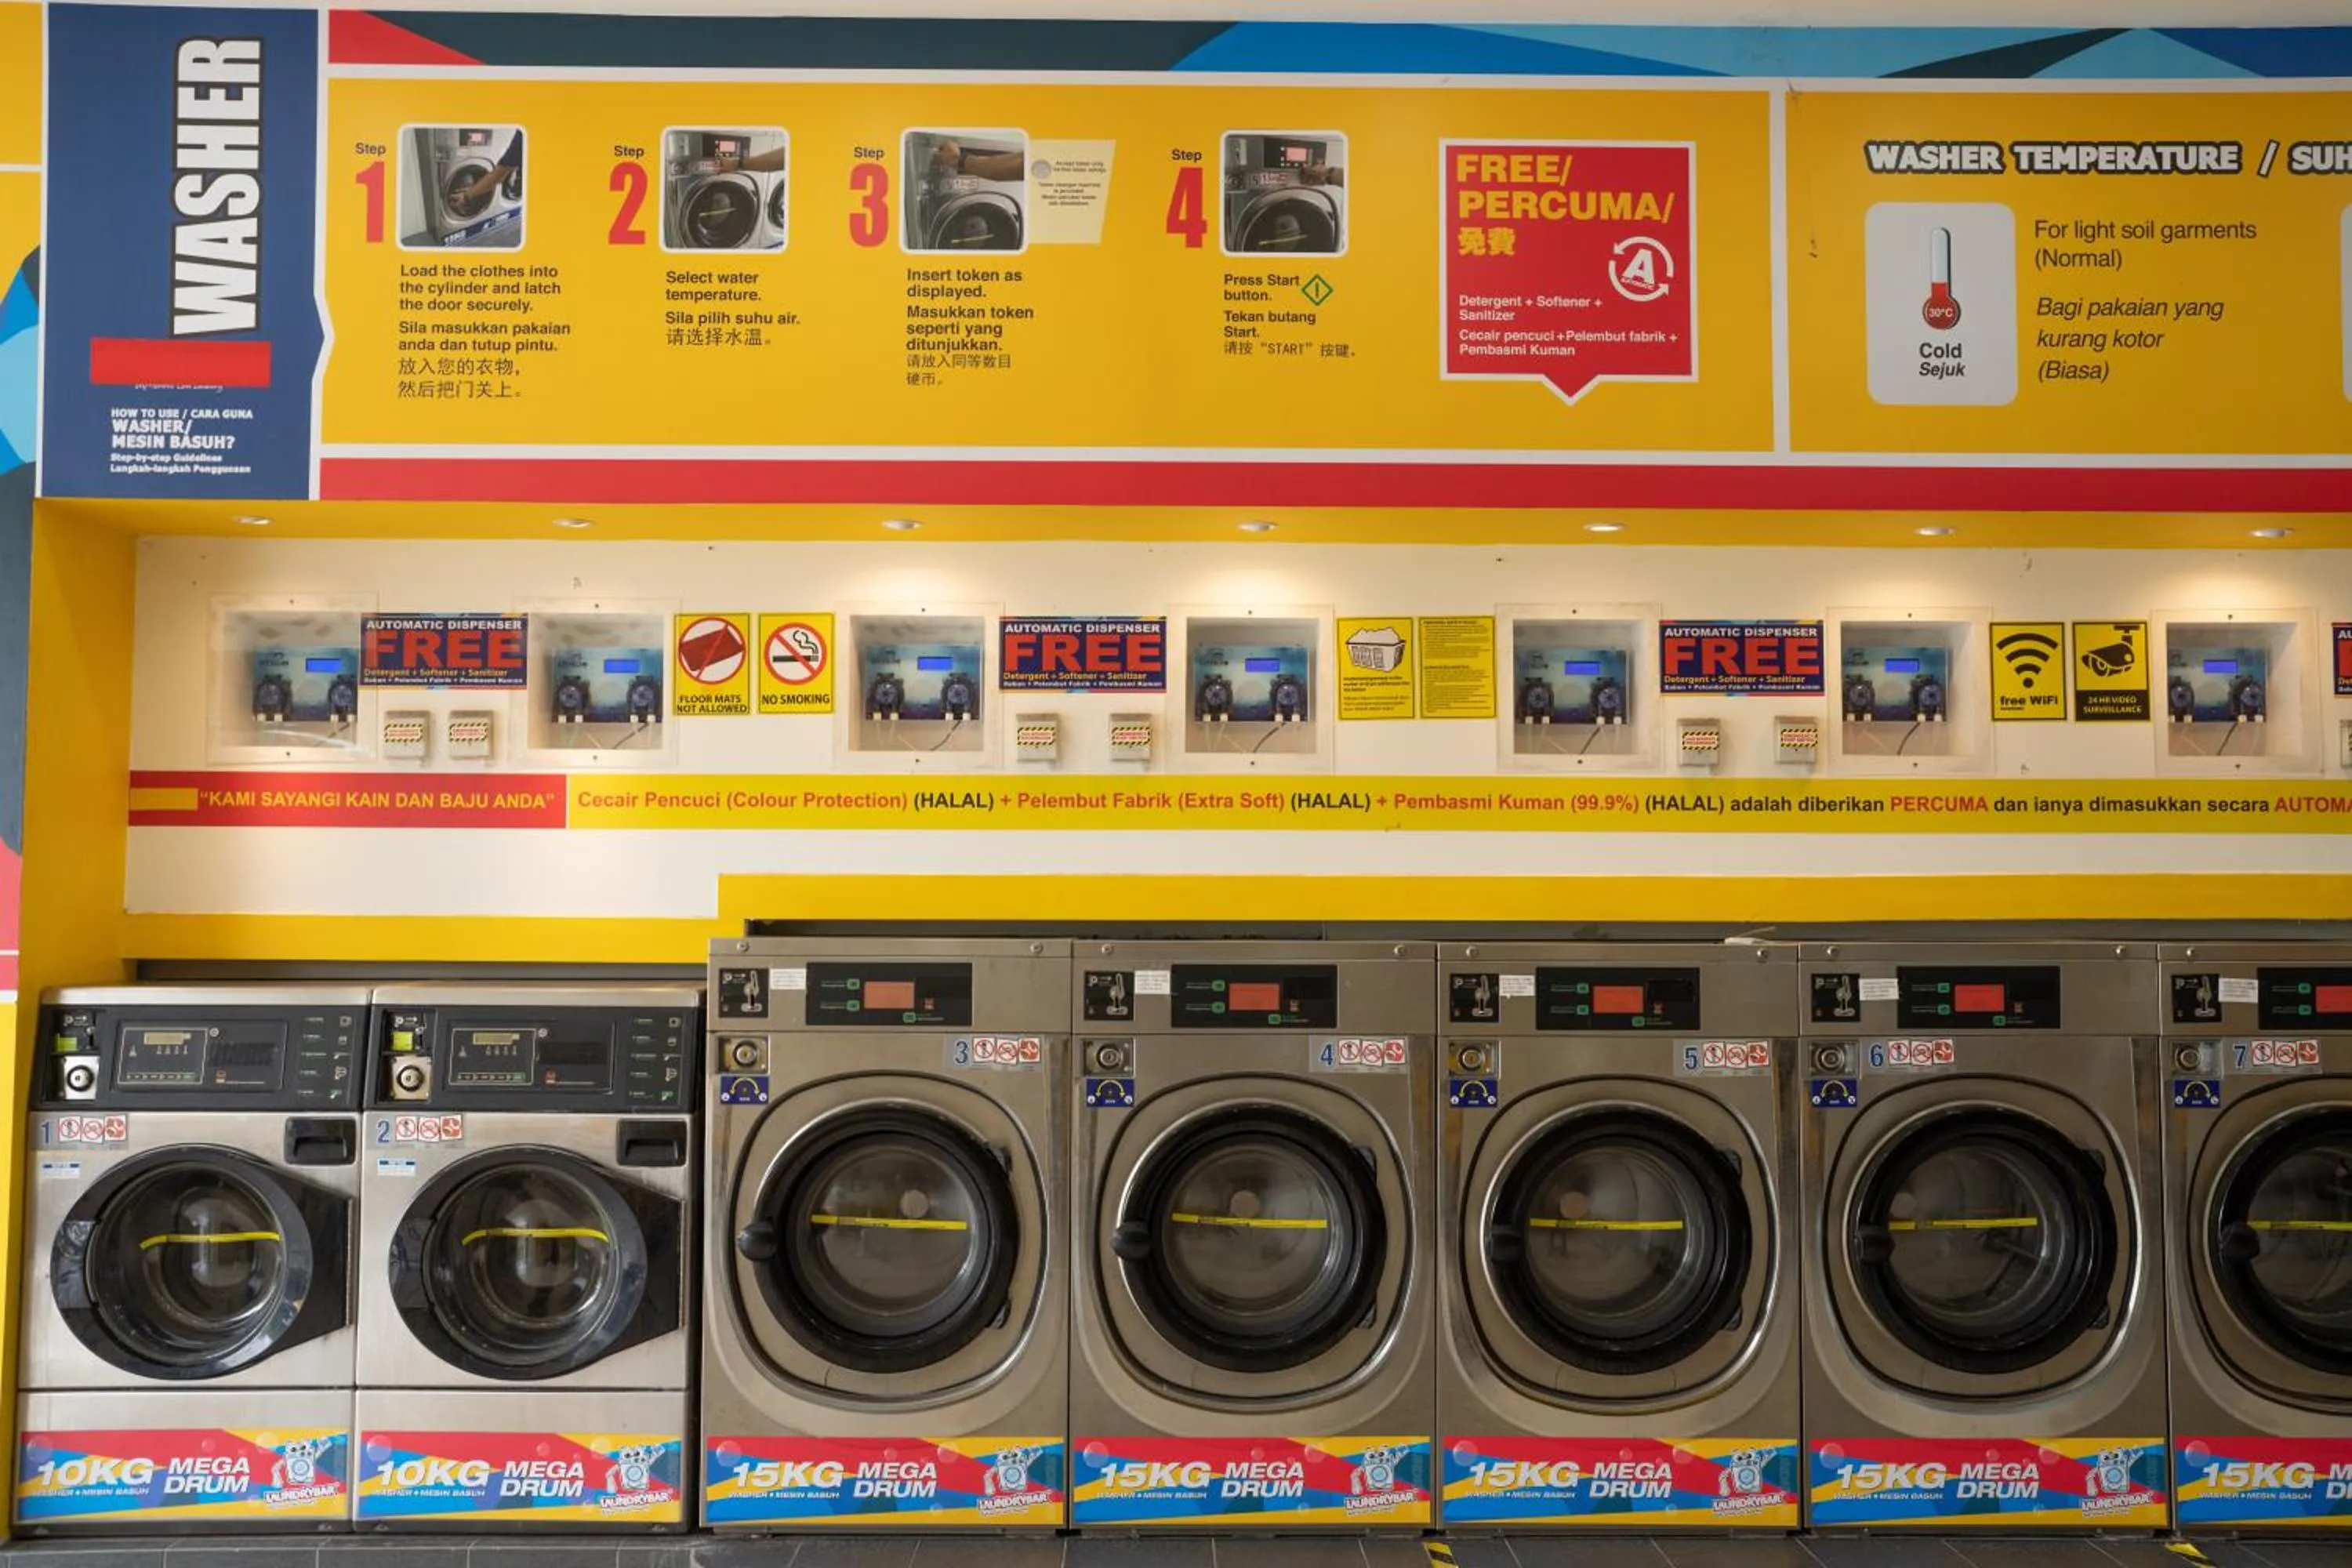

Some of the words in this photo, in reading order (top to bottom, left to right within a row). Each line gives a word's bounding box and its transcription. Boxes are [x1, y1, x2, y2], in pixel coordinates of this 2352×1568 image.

[356, 143, 386, 158] Step
[615, 147, 644, 160] Step
[855, 147, 884, 161] Step
[1172, 150, 1202, 163] Step
[1866, 141, 2004, 172] WASHER
[2012, 141, 2241, 172] TEMPERATURE
[2288, 142, 2352, 173] SUH
[1457, 155, 1571, 187] FREE/
[172, 37, 263, 337] WASHER
[356, 162, 385, 243] 1
[608, 162, 648, 245] 2
[850, 164, 888, 248] 3
[1167, 167, 1207, 249] 4
[1459, 191, 1674, 223] PERCUMA/
[2035, 221, 2067, 239] For
[2075, 221, 2114, 244] light
[2122, 221, 2154, 239] soil
[2161, 222, 2257, 245] garments
[2035, 249, 2122, 271] (Normal)
[401, 265, 437, 277] Load
[442, 266, 466, 277] the
[470, 266, 524, 277] clothes
[530, 267, 557, 277] into
[666, 272, 712, 285] Select
[717, 274, 758, 285] water
[908, 270, 951, 281] Insert
[956, 270, 999, 281] token
[1004, 272, 1022, 281] as
[1225, 275, 1262, 286] Press
[1268, 275, 1299, 286] Start
[401, 282, 423, 294] the
[428, 283, 488, 296] cylinder
[492, 283, 520, 294] and
[525, 283, 561, 295] latch
[666, 289, 760, 303] temperature.
[907, 285, 985, 301] displayed.
[1225, 291, 1272, 302] button.
[400, 299, 423, 311] the
[428, 299, 462, 312] door
[467, 299, 532, 314] securely.
[1459, 295, 1522, 309] Detergent
[1537, 296, 1590, 307] Softener
[2037, 298, 2082, 321] Bagi
[2087, 299, 2167, 321] pakaian
[2173, 303, 2224, 322] yang
[666, 312, 693, 325] Sila
[699, 313, 730, 327] pilih
[735, 314, 772, 325] suhu
[778, 315, 799, 325] air.
[908, 307, 985, 319] Masukkan
[991, 307, 1033, 319] token
[1225, 311, 1264, 323] Tekan
[1269, 312, 1316, 325] butang
[1459, 310, 1515, 322] Sanitizer
[400, 322, 426, 334] Sila
[432, 322, 507, 335] masukkan
[513, 323, 570, 337] pakaian
[907, 323, 960, 338] seperti
[965, 325, 1002, 338] yang
[1225, 327, 1259, 338] Start.
[1459, 331, 1501, 342] Cecair
[1504, 332, 1554, 343] pencuci
[1630, 332, 1665, 343] fabrik
[399, 339, 434, 351] anda
[440, 339, 467, 351] dan
[472, 340, 511, 354] tutup
[516, 339, 557, 354] pintu.
[906, 339, 1002, 354] ditunjukkan.
[2038, 330, 2107, 353] kurang
[2113, 330, 2164, 349] kotor
[1460, 344, 1526, 356] Pembasmi
[1530, 344, 1575, 356] Kuman
[1920, 343, 1962, 359] Cold
[1919, 363, 1965, 380] Sejuk
[2038, 361, 2109, 384] (Biasa)
[111, 409, 138, 419] HOW
[141, 409, 155, 419] TO
[112, 419, 192, 434] WASHER/
[113, 436, 165, 448] MESIN
[170, 436, 235, 449] BASUH?
[367, 620, 444, 630] AUTOMATIC
[448, 620, 522, 630] DISPENSER
[365, 630, 522, 668] FREE
[1004, 634, 1160, 671] FREE
[715, 695, 741, 704] MATS
[762, 695, 778, 705] NO
[781, 695, 829, 705] SMOKING
[2001, 697, 2026, 706] free
[2030, 696, 2057, 706] WiFi
[677, 703, 695, 713] NOT
[699, 703, 746, 713] ALLOWED
[261, 792, 340, 808] SAYANGI
[346, 793, 389, 808] KAIN
[396, 794, 434, 808] DAN
[441, 794, 488, 808] BAJU
[579, 793, 638, 808] Cecair
[645, 793, 720, 808] Pencuci
[727, 793, 797, 811] (Colour
[804, 793, 907, 811] Protection)
[914, 793, 993, 812] (HALAL)
[1018, 793, 1106, 808] Pelembut
[1113, 793, 1171, 808] Fabrik
[1178, 793, 1233, 811] (Extra
[1240, 793, 1284, 813] Soft)
[1291, 793, 1370, 813] (HALAL)
[1395, 794, 1492, 811] Pembasmi
[1498, 795, 1564, 811] Kuman
[1571, 795, 1639, 815] (99.9%)
[1646, 796, 1724, 815] (HALAL)
[1731, 797, 1791, 812] adalah
[1798, 797, 1883, 813] diberikan
[1891, 797, 1988, 813] PERCUMA
[1994, 797, 2027, 812] dan
[2034, 797, 2082, 816] ianya
[2089, 797, 2201, 812] dimasukkan
[2208, 801, 2269, 813] secara
[956, 1041, 968, 1063] 3
[1321, 1044, 1333, 1065] 4
[1685, 1047, 1697, 1069] 5
[1870, 1044, 1883, 1066] 6
[2234, 1046, 2246, 1066] 7
[42, 1122, 49, 1143] 1
[377, 1120, 389, 1143] 2
[38, 1457, 154, 1486] 10KG
[168, 1457, 250, 1475] MEGA
[857, 1462, 937, 1479] MEGA
[733, 1461, 844, 1488] 15KG
[2202, 1462, 2315, 1489] 15KG
[164, 1475, 249, 1494] DRUM
[854, 1480, 937, 1498] DRUM
